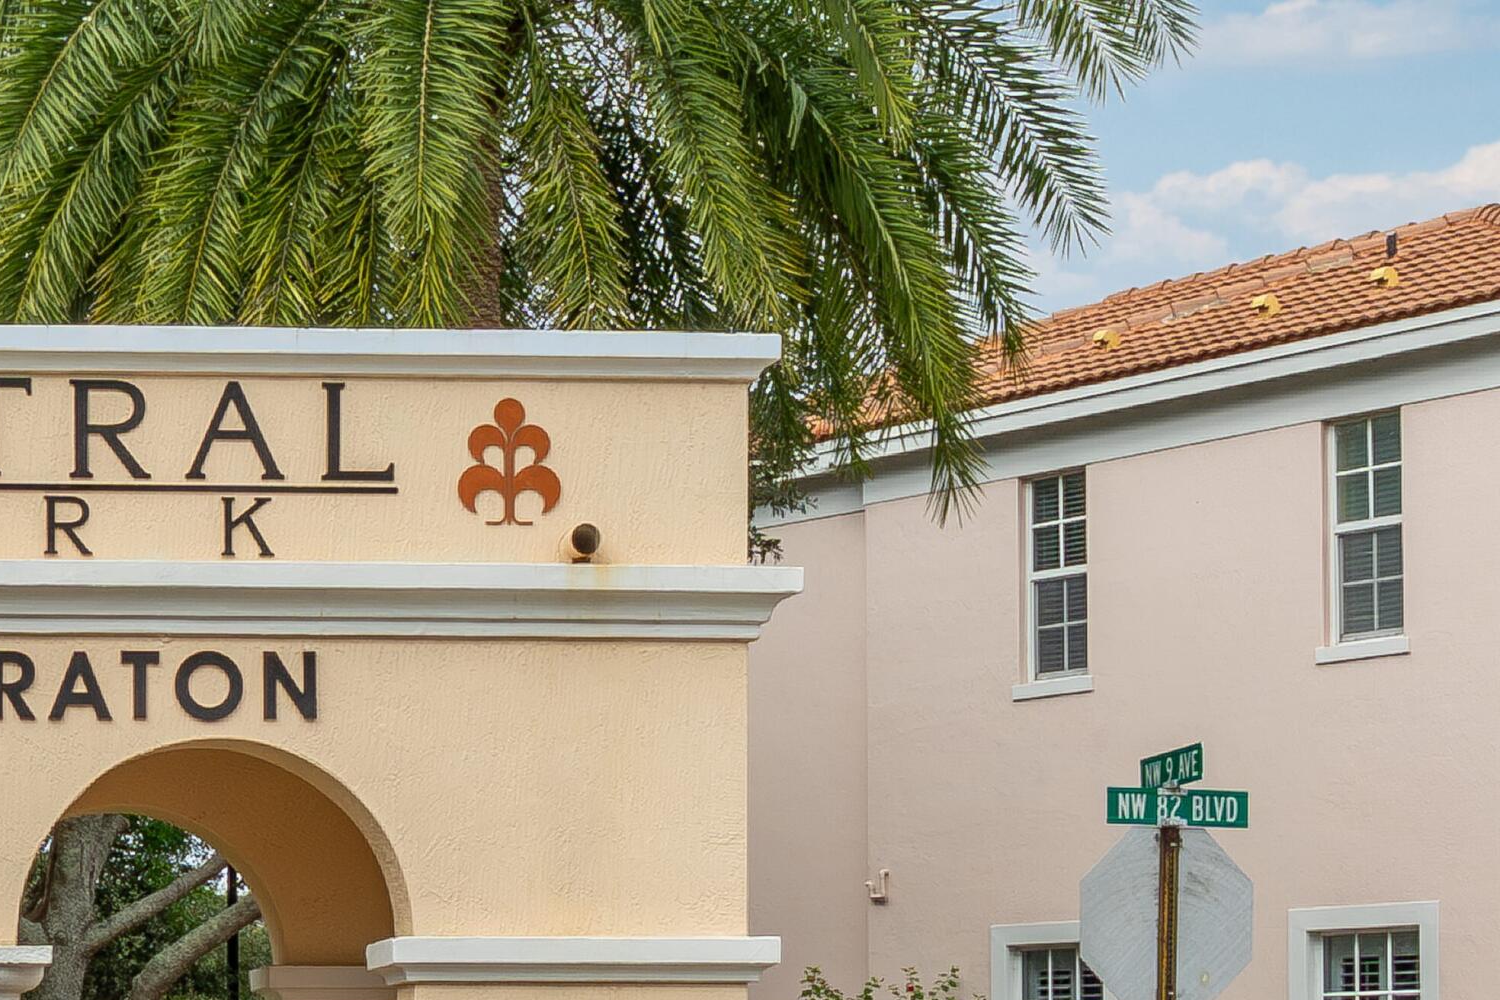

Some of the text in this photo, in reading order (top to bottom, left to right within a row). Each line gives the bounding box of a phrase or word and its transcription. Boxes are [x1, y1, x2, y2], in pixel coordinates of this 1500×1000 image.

[1144, 749, 1199, 788] NW 9 AVE
[1118, 793, 1238, 822] NW 82 BLVD
